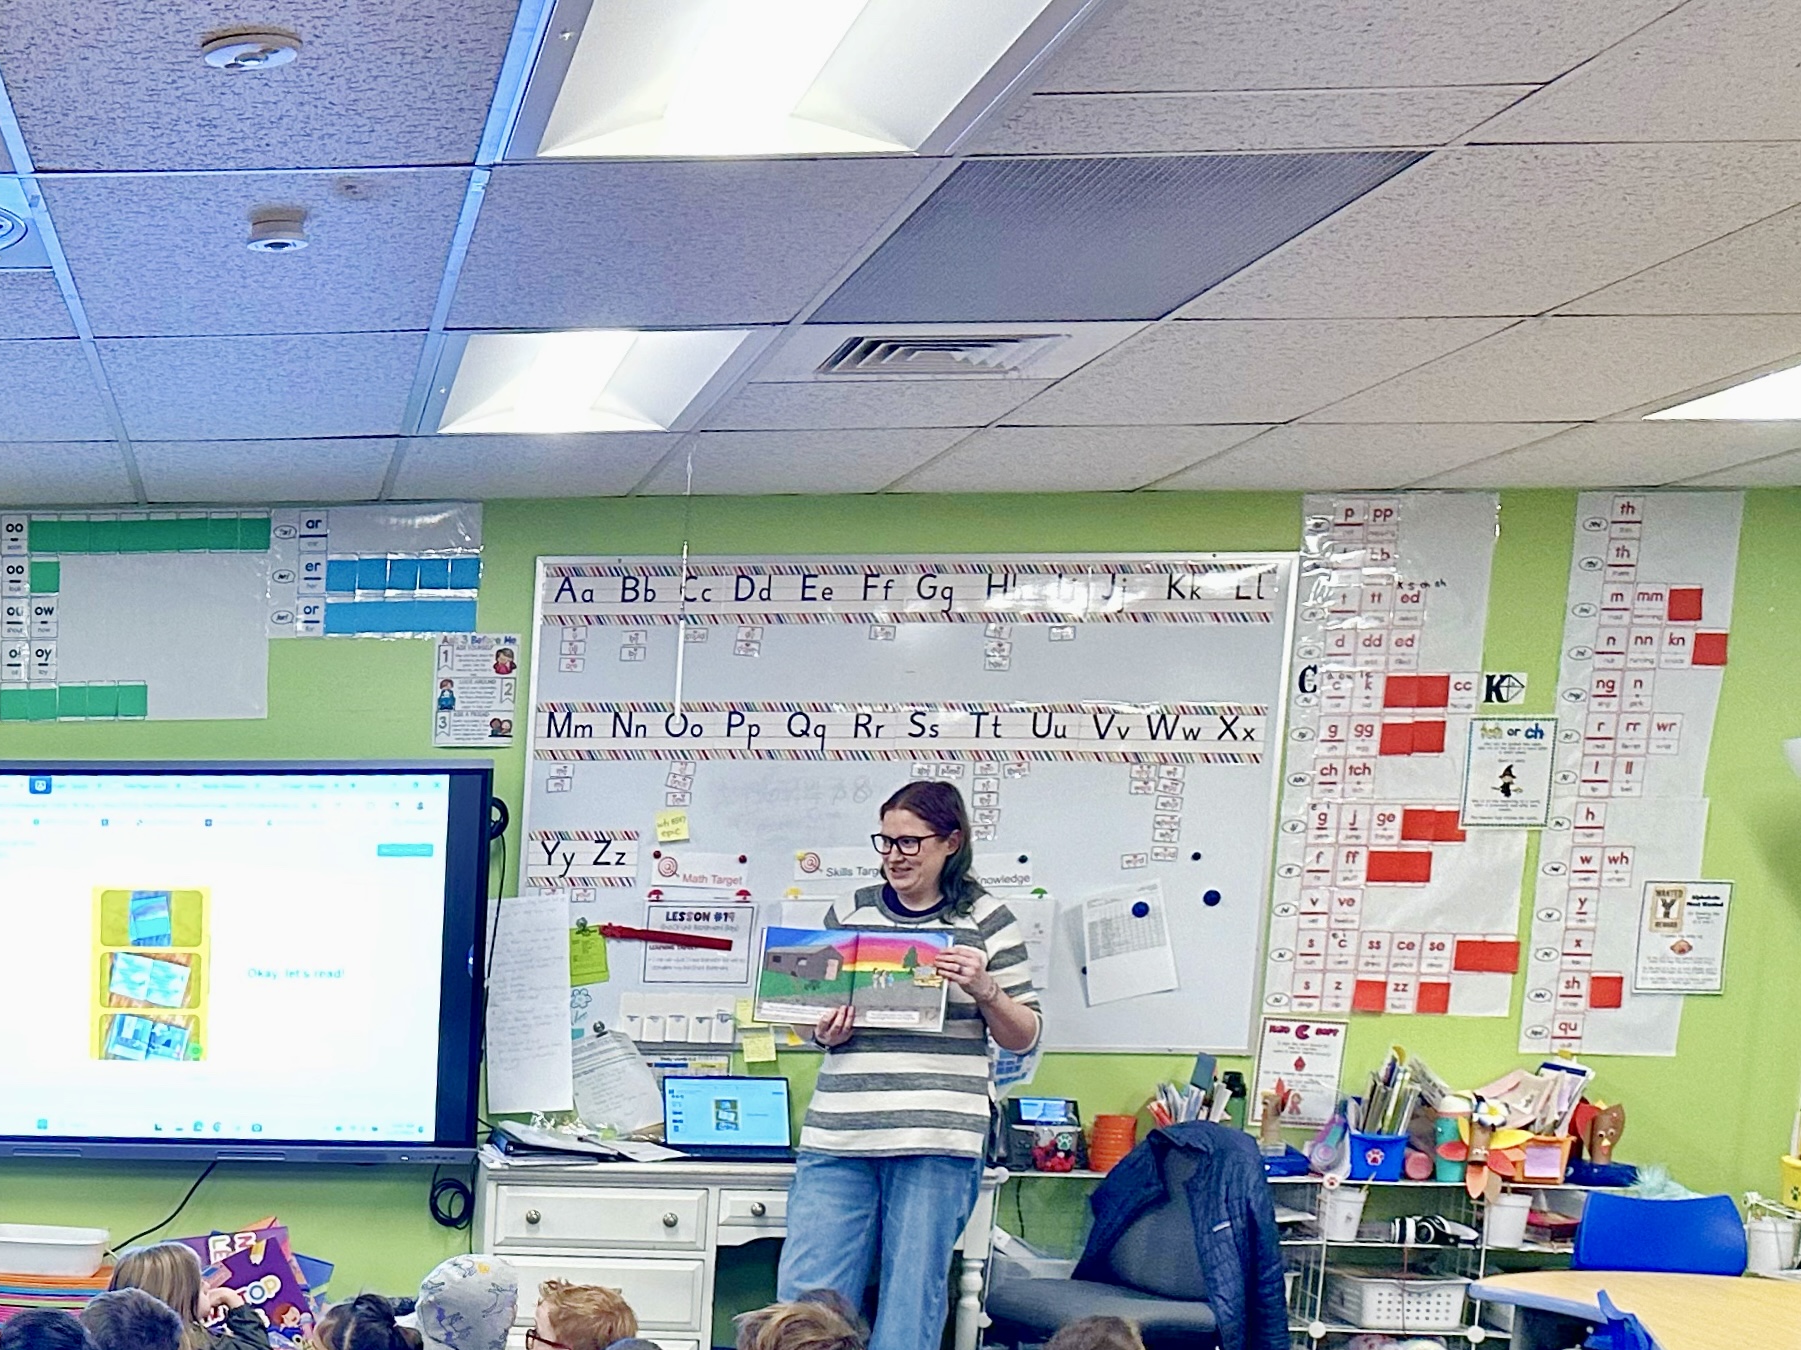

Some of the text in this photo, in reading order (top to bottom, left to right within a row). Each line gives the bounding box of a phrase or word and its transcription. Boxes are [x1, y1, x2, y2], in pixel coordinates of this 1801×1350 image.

[1620, 501, 1636, 515] th
[1373, 507, 1393, 522] pp
[6, 523, 24, 532] oo
[305, 519, 322, 529] ar
[1615, 545, 1631, 558] th
[6, 565, 24, 574] oo
[305, 562, 321, 571] er
[554, 573, 1201, 613] Aa Bb Cc Dd Ee Ff Gg Kk
[1401, 591, 1421, 604] ed
[1637, 592, 1663, 602] mm
[34, 606, 54, 616] ow
[303, 605, 319, 615] or
[1363, 634, 1415, 648] dd ed
[1634, 632, 1685, 646] nn kn
[35, 648, 52, 661] oy
[1454, 681, 1472, 691] cc
[1596, 679, 1615, 693] ng
[438, 717, 448, 729] 3
[1657, 722, 1677, 732] wr
[546, 711, 1255, 750] Mm Nn Oo Pp Qq Rr Ss Tt Uu Vv Ww Xx
[1354, 724, 1374, 738] gg
[1507, 722, 1545, 739] or ch
[1319, 762, 1371, 776] ch tch
[661, 827, 682, 837] epic
[541, 840, 626, 878] Yy Zz
[1608, 852, 1629, 864] wh
[826, 867, 853, 877] Skills
[683, 872, 743, 886] Math Target
[978, 873, 1030, 885] nowledge
[1338, 897, 1355, 906] ve
[665, 911, 735, 922] LESSON #19
[1368, 940, 1446, 951] ss ce se
[1565, 976, 1580, 990] sh
[1559, 1020, 1577, 1034] qu
